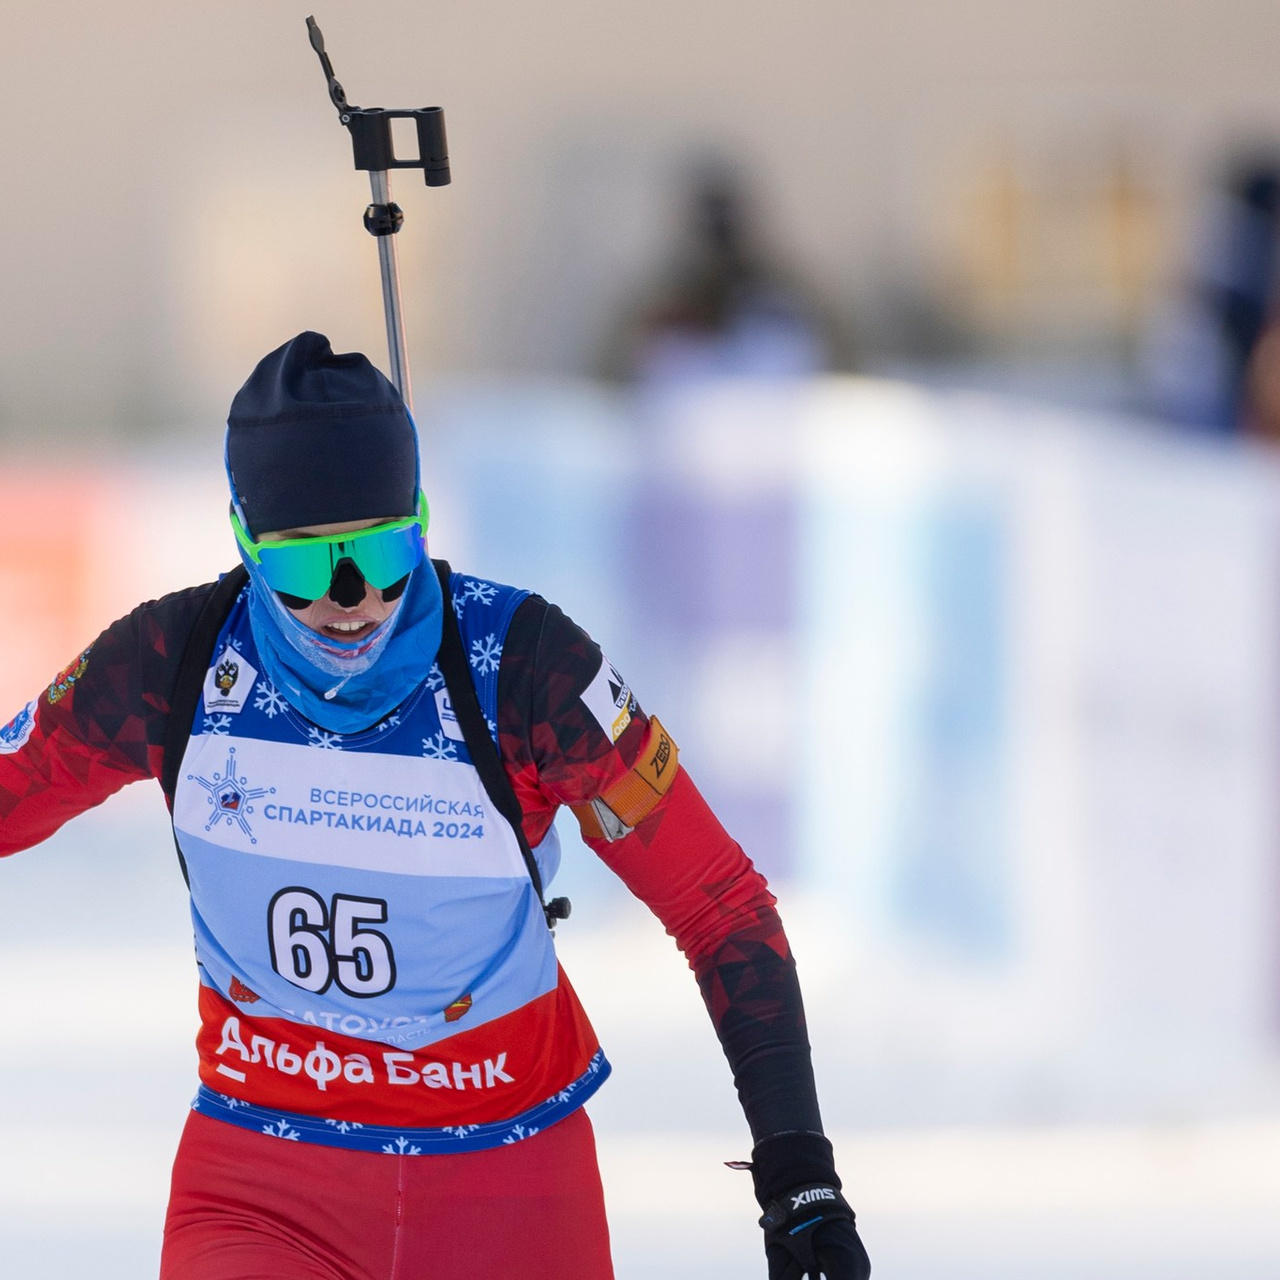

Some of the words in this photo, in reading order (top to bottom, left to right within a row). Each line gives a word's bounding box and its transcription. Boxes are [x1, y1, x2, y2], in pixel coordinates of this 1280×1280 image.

[649, 732, 671, 780] ZERO
[263, 804, 427, 838] СПАРТАКИАДА
[432, 821, 485, 839] 2024
[310, 787, 485, 819] ВСЕРОССИЙСКАЯ
[267, 886, 397, 999] 65
[216, 1015, 375, 1091] Альфа
[382, 1051, 516, 1091] Банк
[790, 1187, 836, 1210] SWIX
